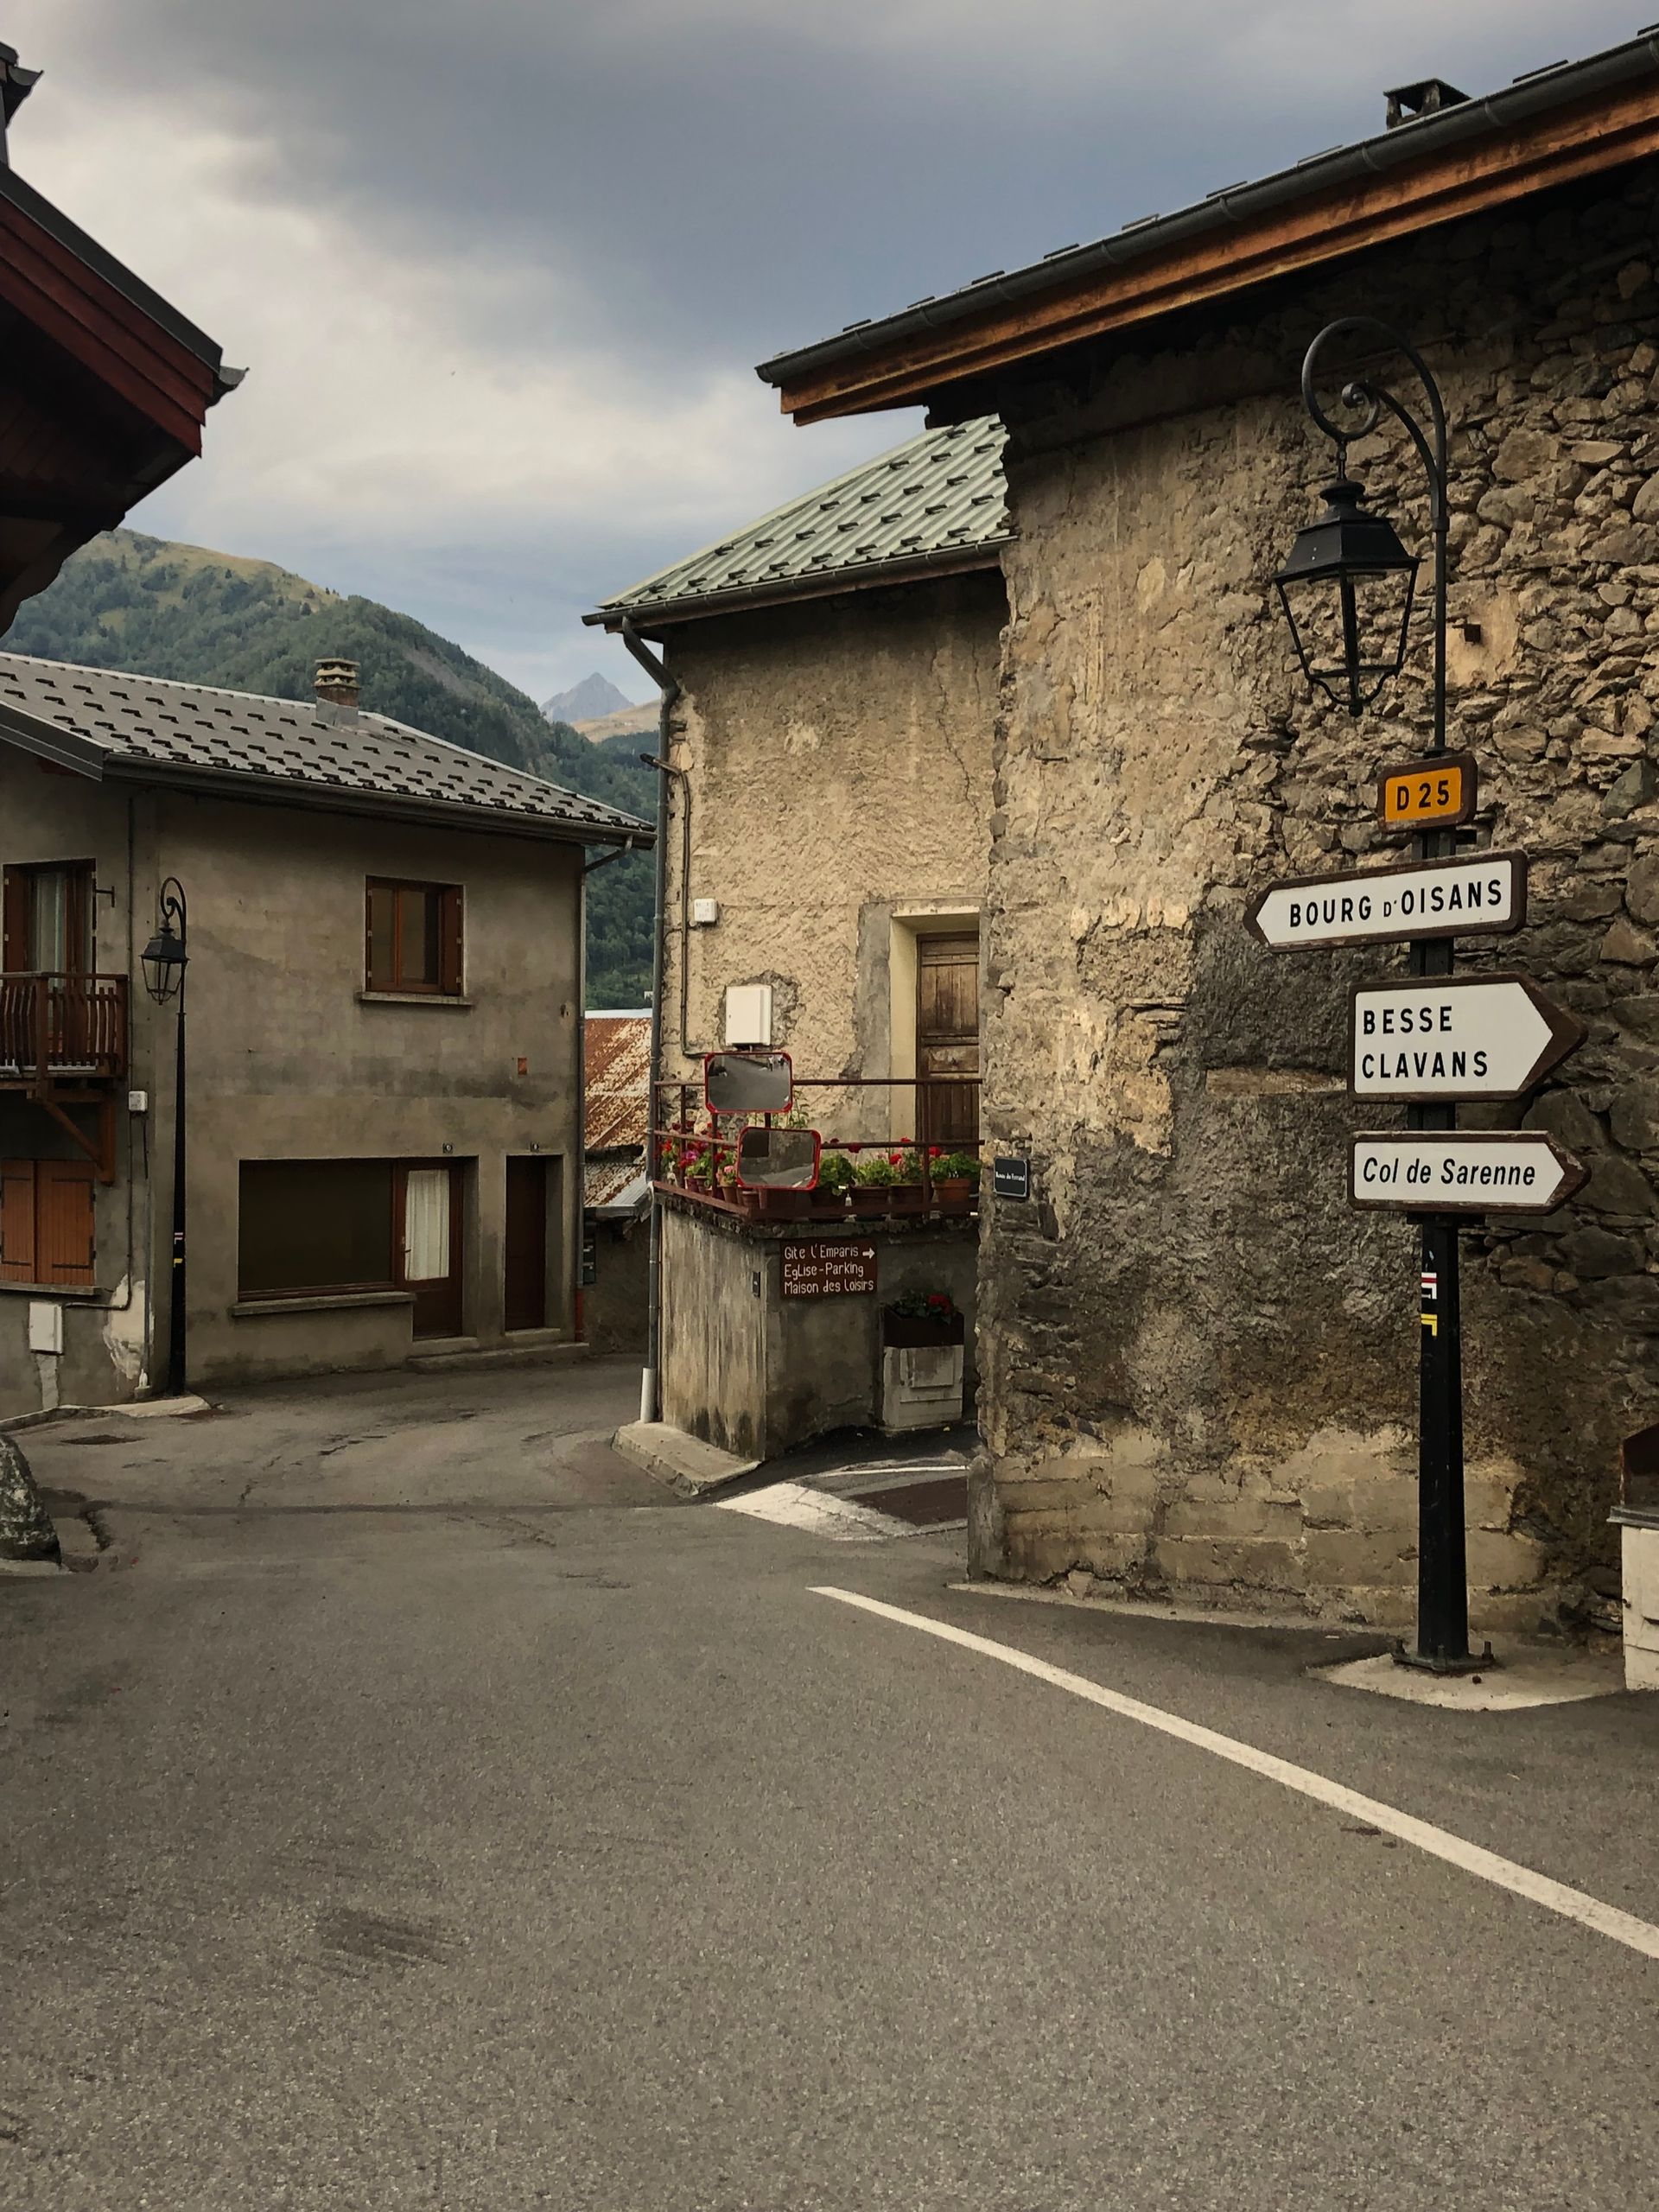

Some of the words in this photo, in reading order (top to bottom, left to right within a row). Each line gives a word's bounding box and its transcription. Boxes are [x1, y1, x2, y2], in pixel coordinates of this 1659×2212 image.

[1396, 785, 1410, 811] D
[1418, 779, 1450, 809] 25
[1289, 895, 1372, 928] BOURG
[1363, 1005, 1452, 1035] BESSE
[1362, 1050, 1488, 1079] CLAVANS
[1363, 1157, 1399, 1184] Col
[1406, 1158, 1432, 1184] de
[1440, 1158, 1535, 1186] Sarenne
[784, 1281, 819, 1294] Maison
[823, 1279, 841, 1293] des
